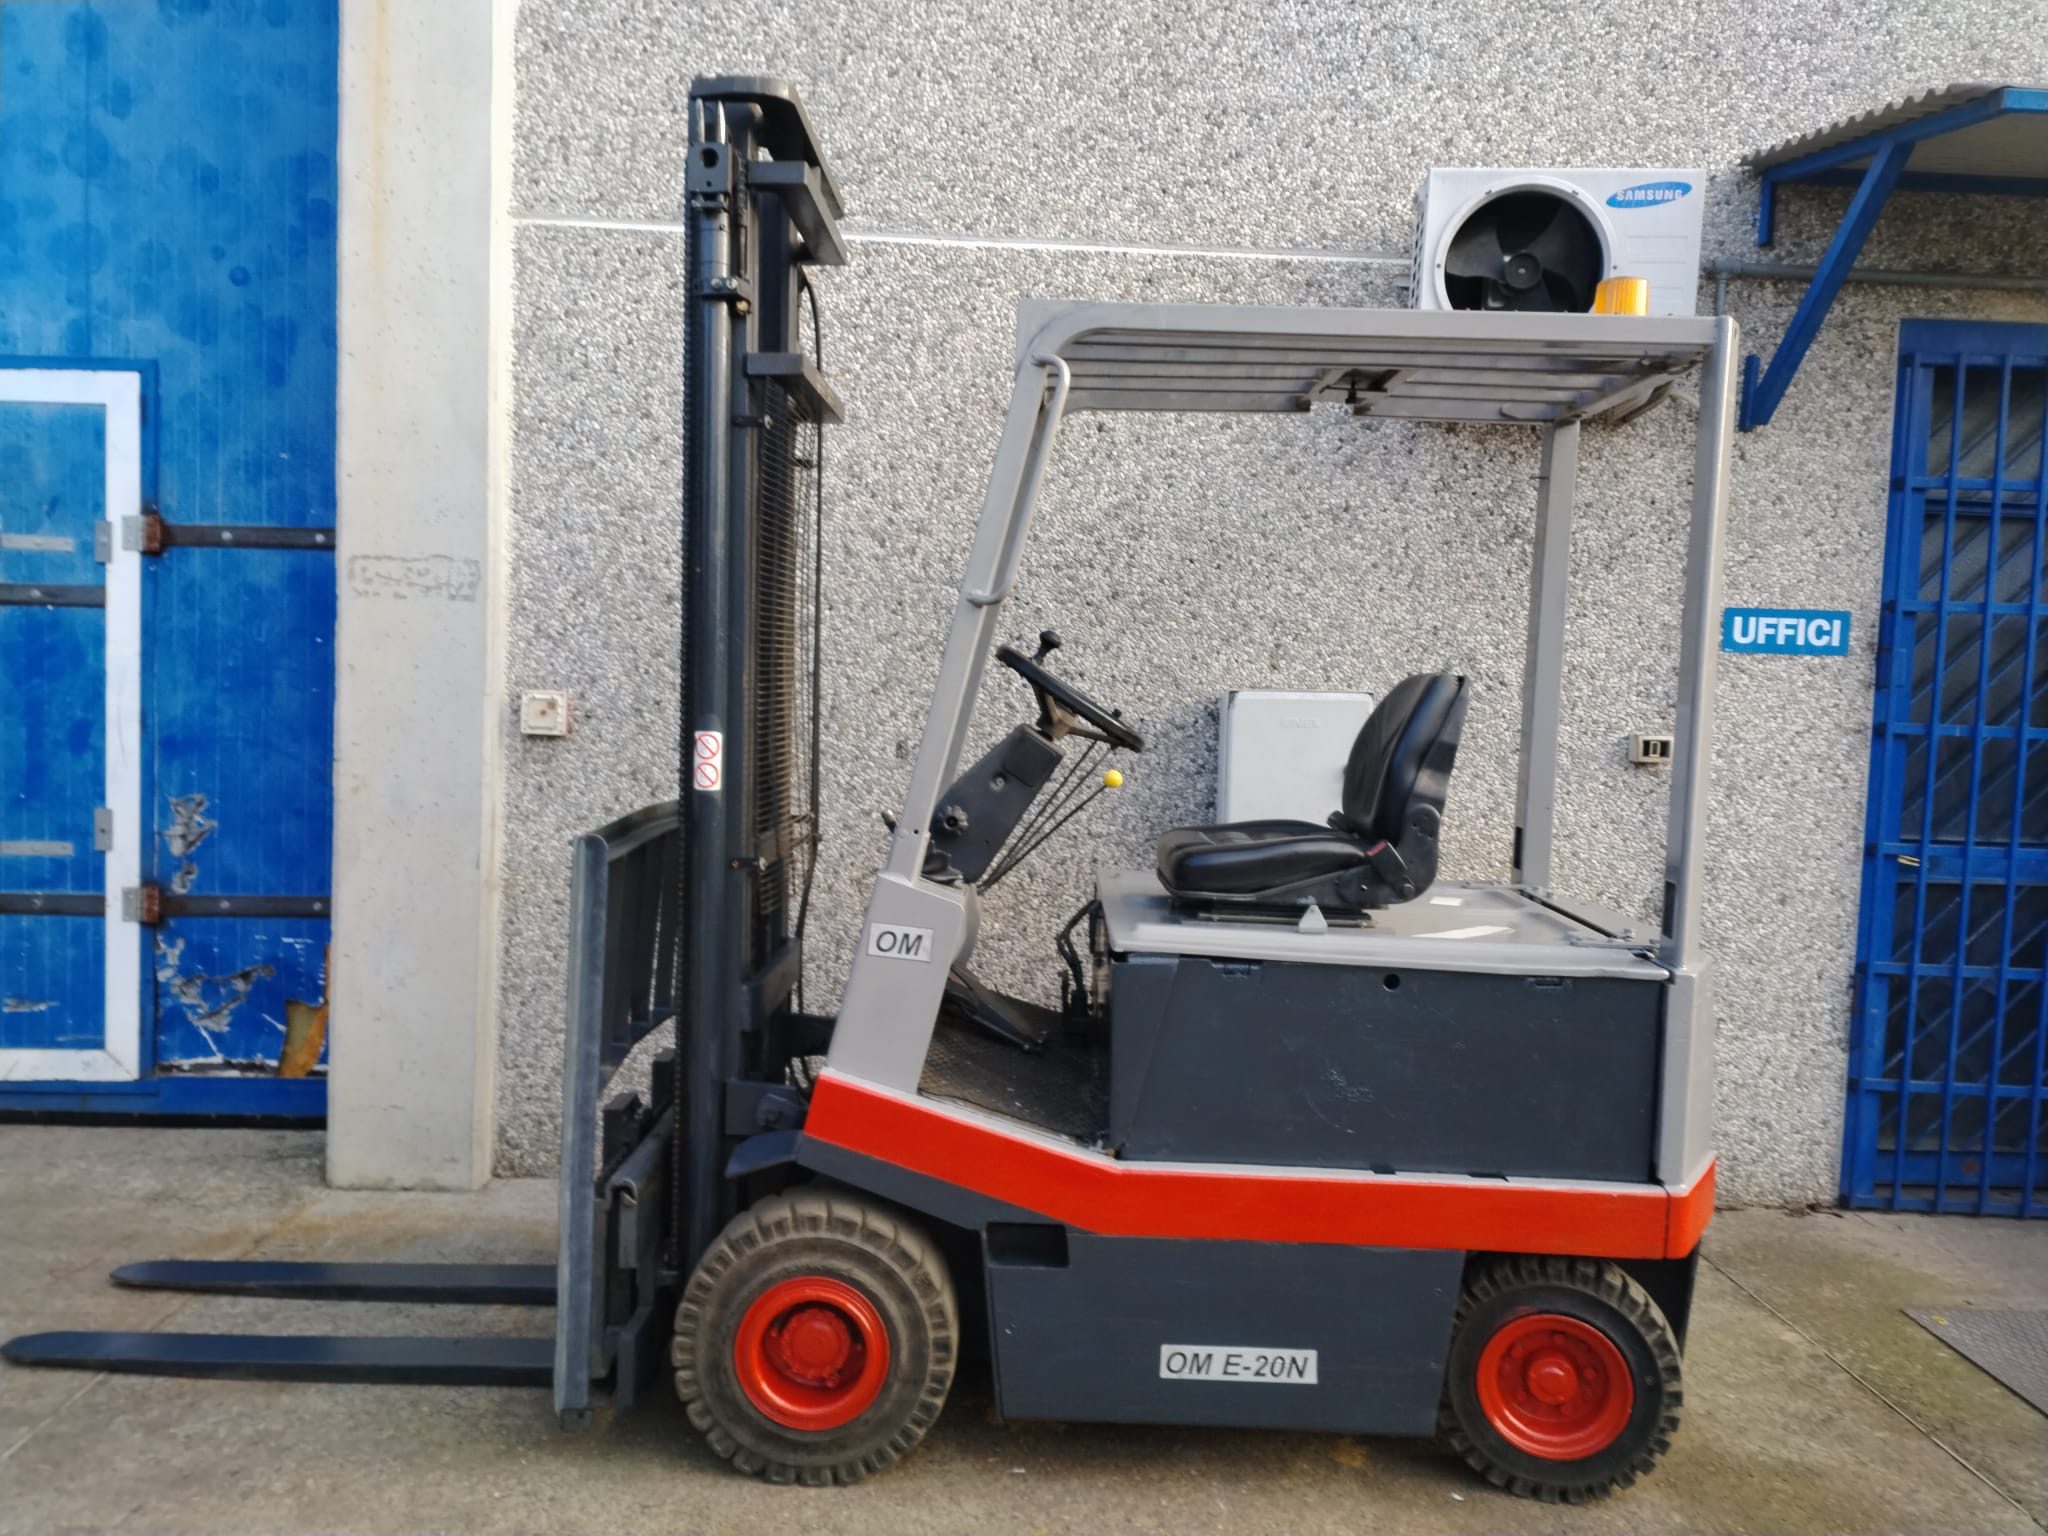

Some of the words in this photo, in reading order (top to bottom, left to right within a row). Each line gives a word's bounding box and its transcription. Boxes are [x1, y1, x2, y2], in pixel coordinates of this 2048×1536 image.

[1616, 189, 1683, 201] SAMSUNG
[1732, 616, 1842, 647] UFFICI
[876, 930, 924, 956] OM
[1166, 1351, 1213, 1376] OM
[1222, 1353, 1308, 1379] E-20N
